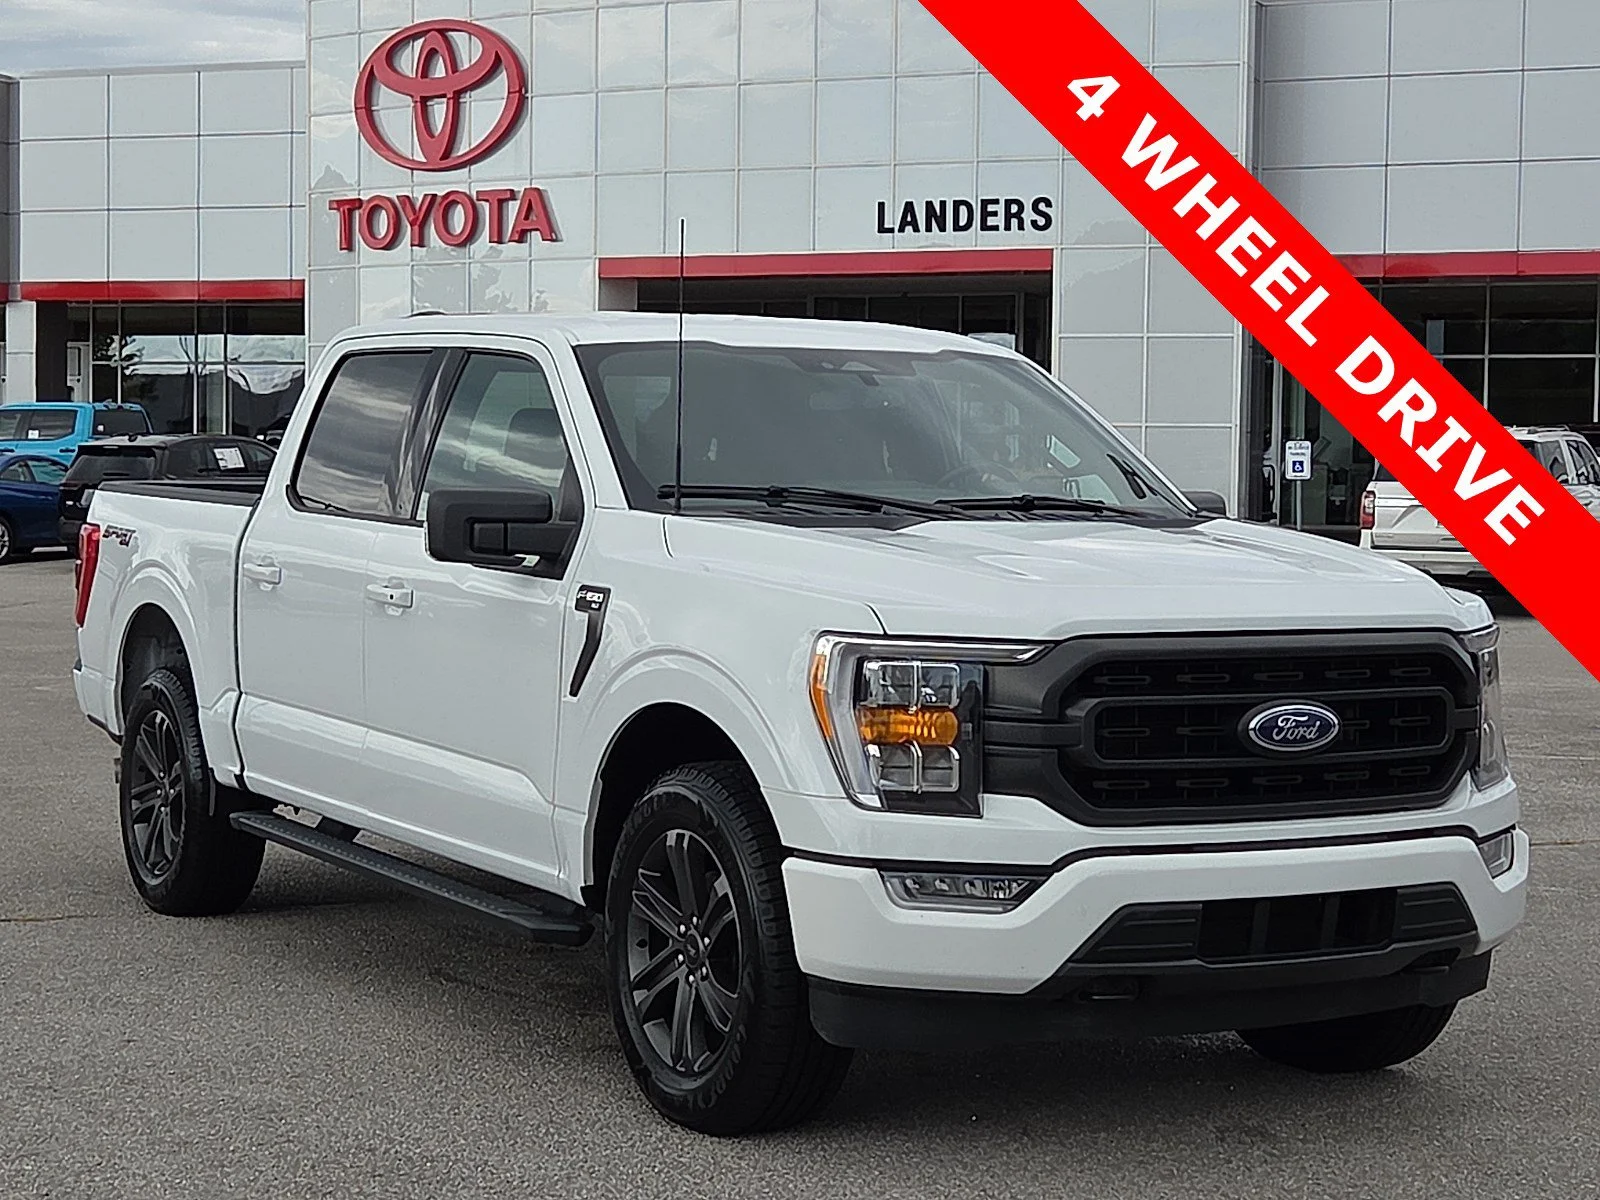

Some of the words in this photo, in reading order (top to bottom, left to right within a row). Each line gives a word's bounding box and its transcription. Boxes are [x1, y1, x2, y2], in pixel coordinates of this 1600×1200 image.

[328, 187, 560, 251] TOYOTA
[877, 196, 1053, 234] LANDERS
[1272, 715, 1320, 740] Ford
